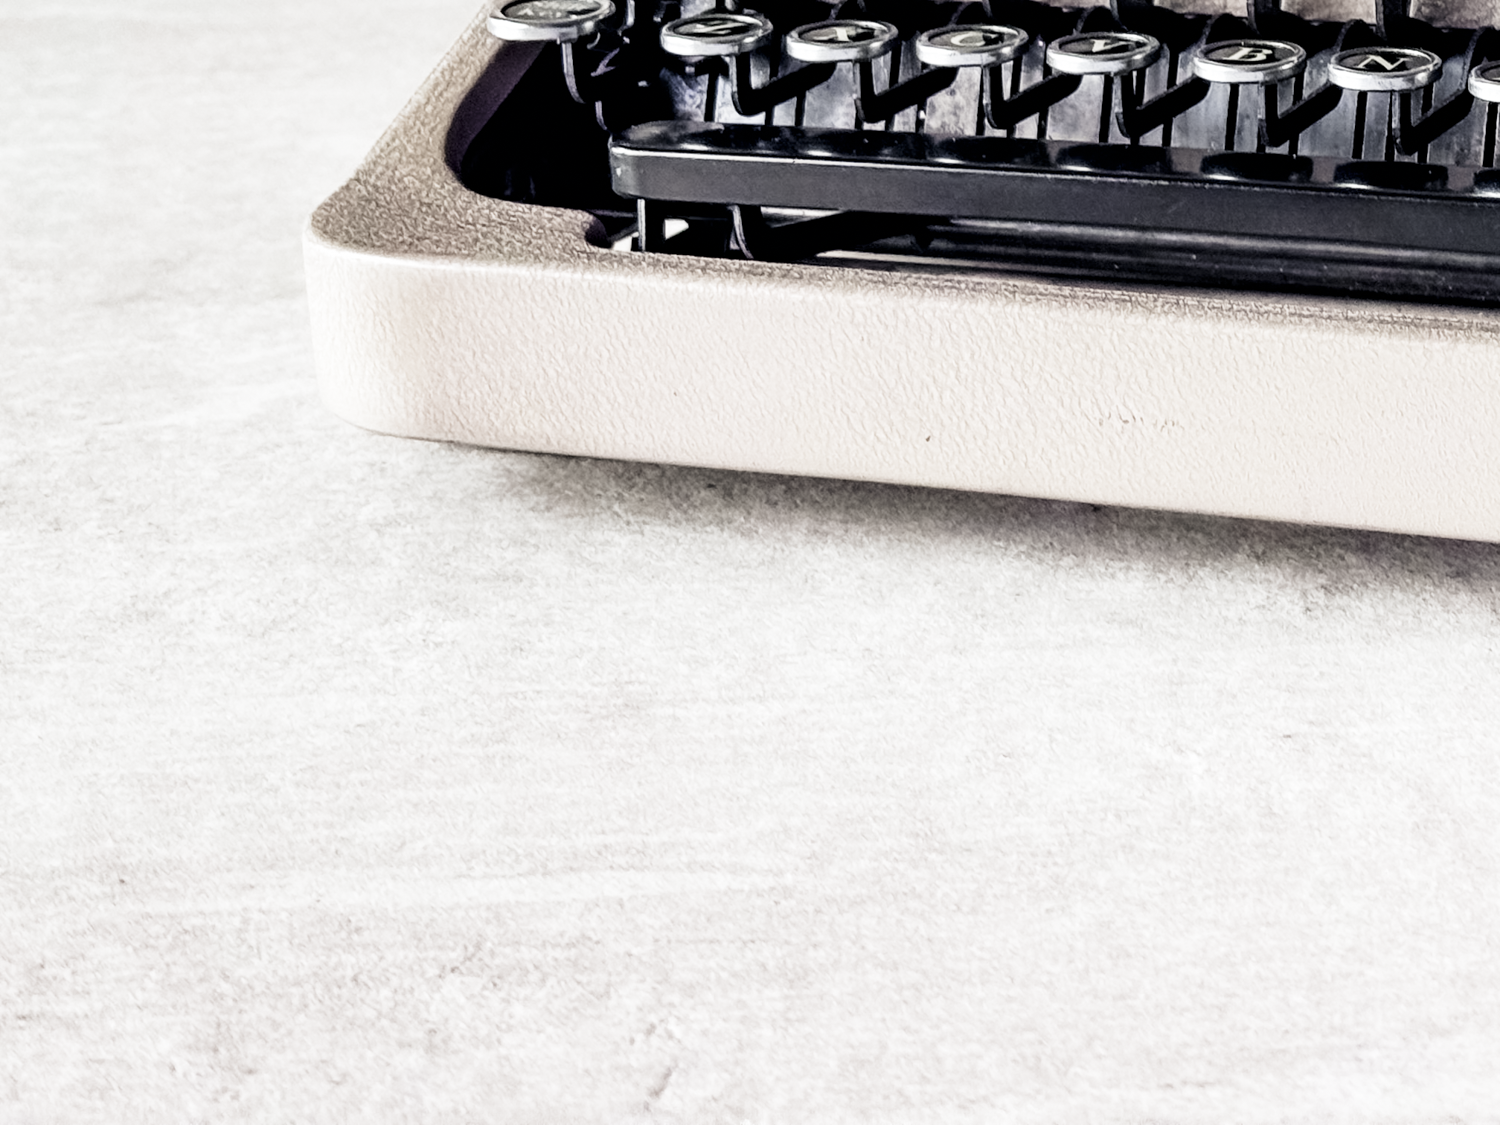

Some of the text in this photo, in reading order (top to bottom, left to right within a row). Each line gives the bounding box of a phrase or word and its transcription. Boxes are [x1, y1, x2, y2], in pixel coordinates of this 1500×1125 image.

[949, 32, 999, 48] C
[1088, 39, 1138, 54] V
[1218, 47, 1273, 63] B
[1356, 55, 1410, 71] N
